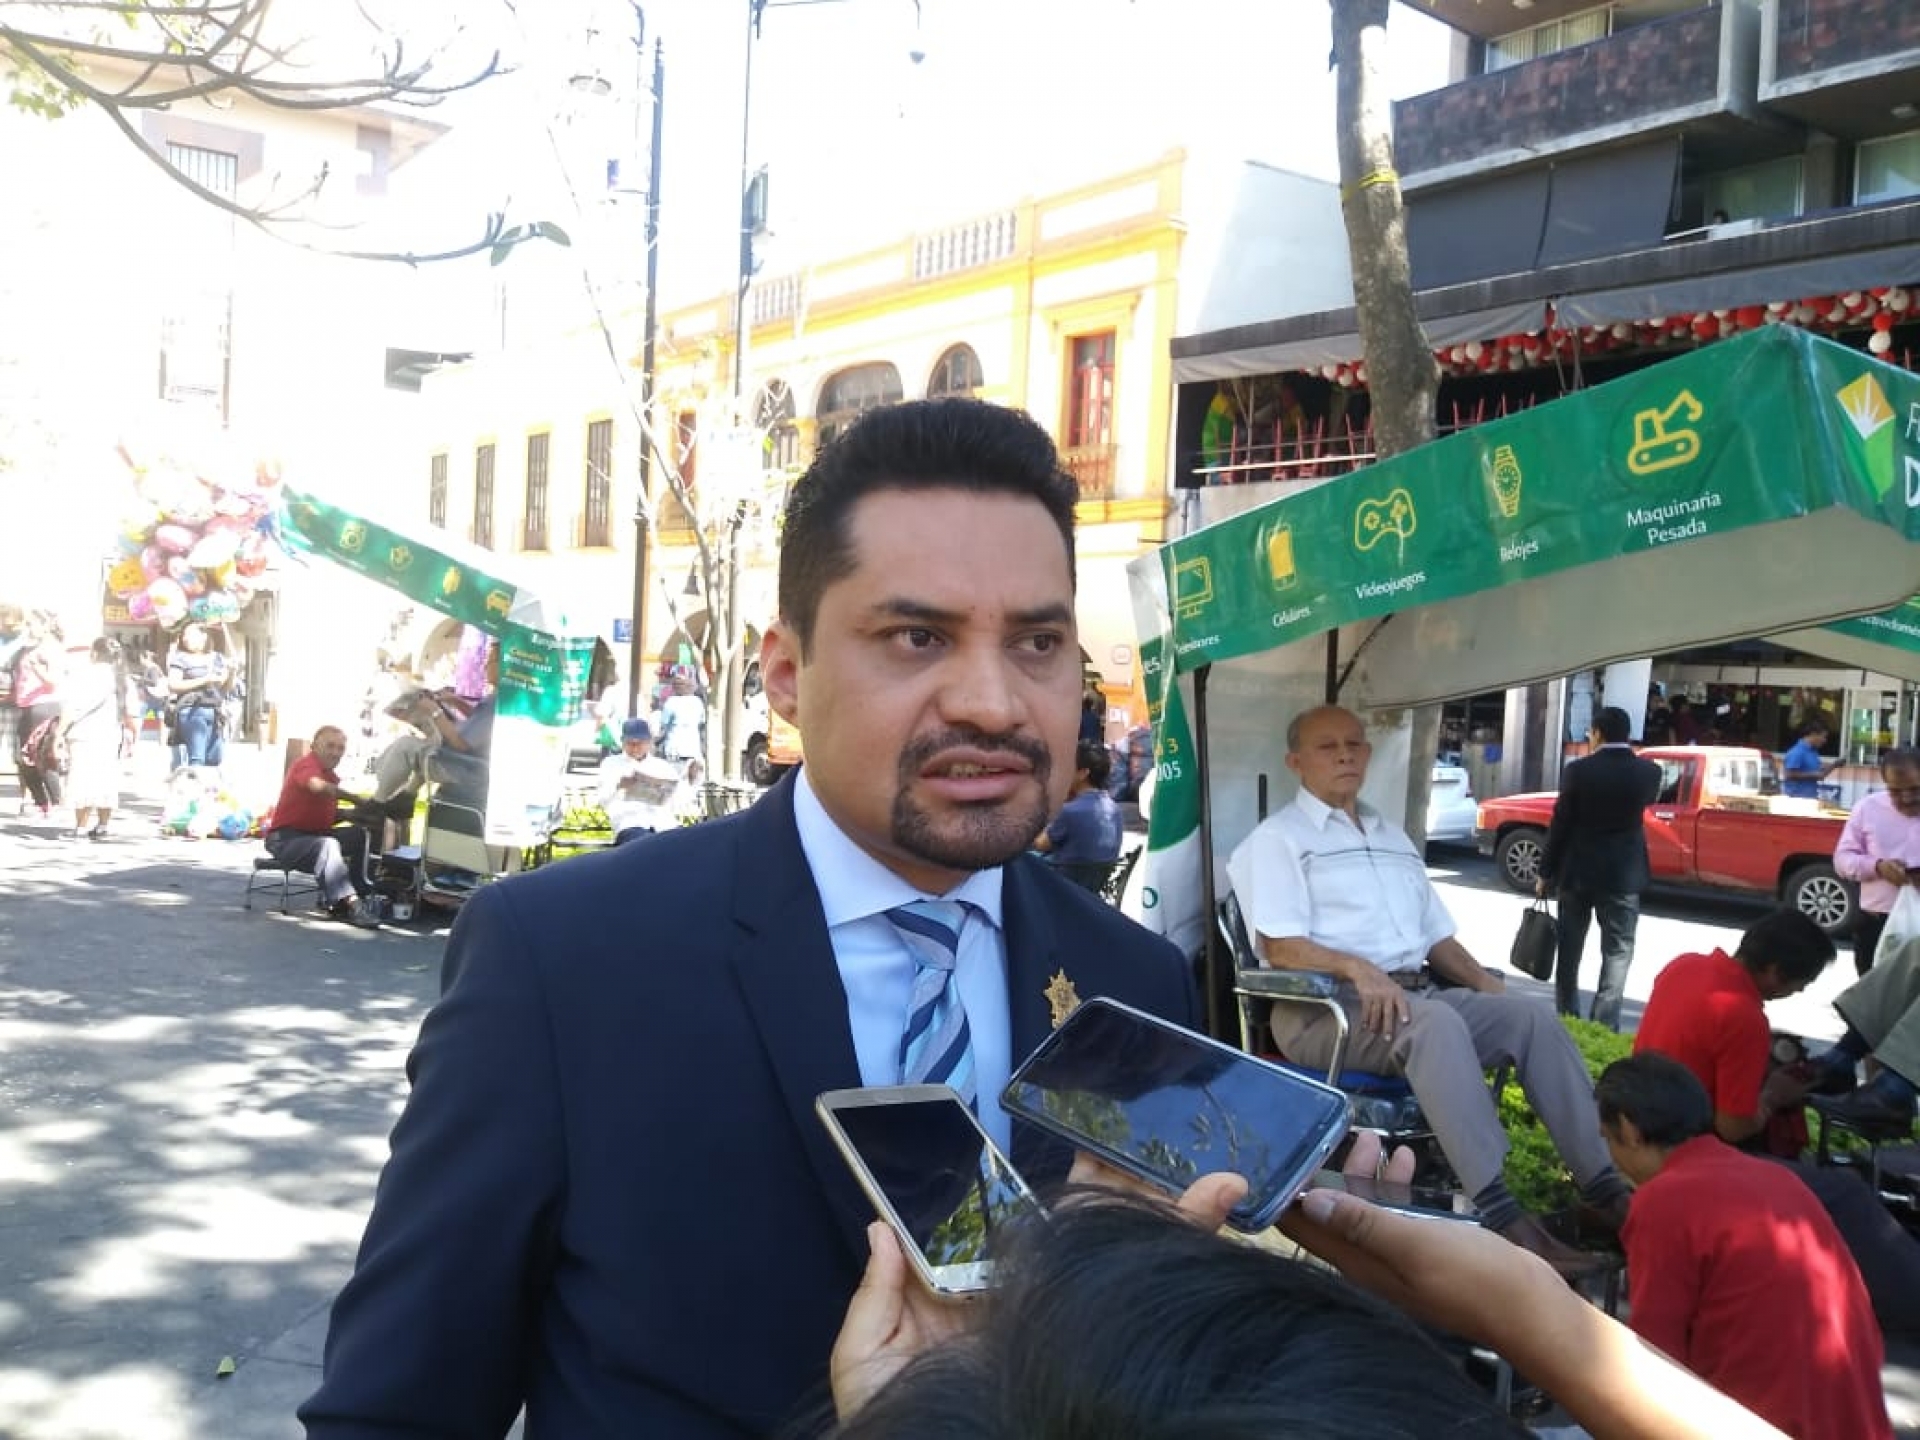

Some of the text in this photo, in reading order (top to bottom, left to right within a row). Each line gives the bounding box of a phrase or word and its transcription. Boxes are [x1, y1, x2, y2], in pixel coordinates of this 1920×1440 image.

[1627, 490, 1722, 528] Maquinaria
[1647, 516, 1707, 546] Pesada
[1500, 534, 1539, 562] Relojes
[1356, 571, 1427, 599] Videojuegos
[1166, 738, 1178, 754] 3
